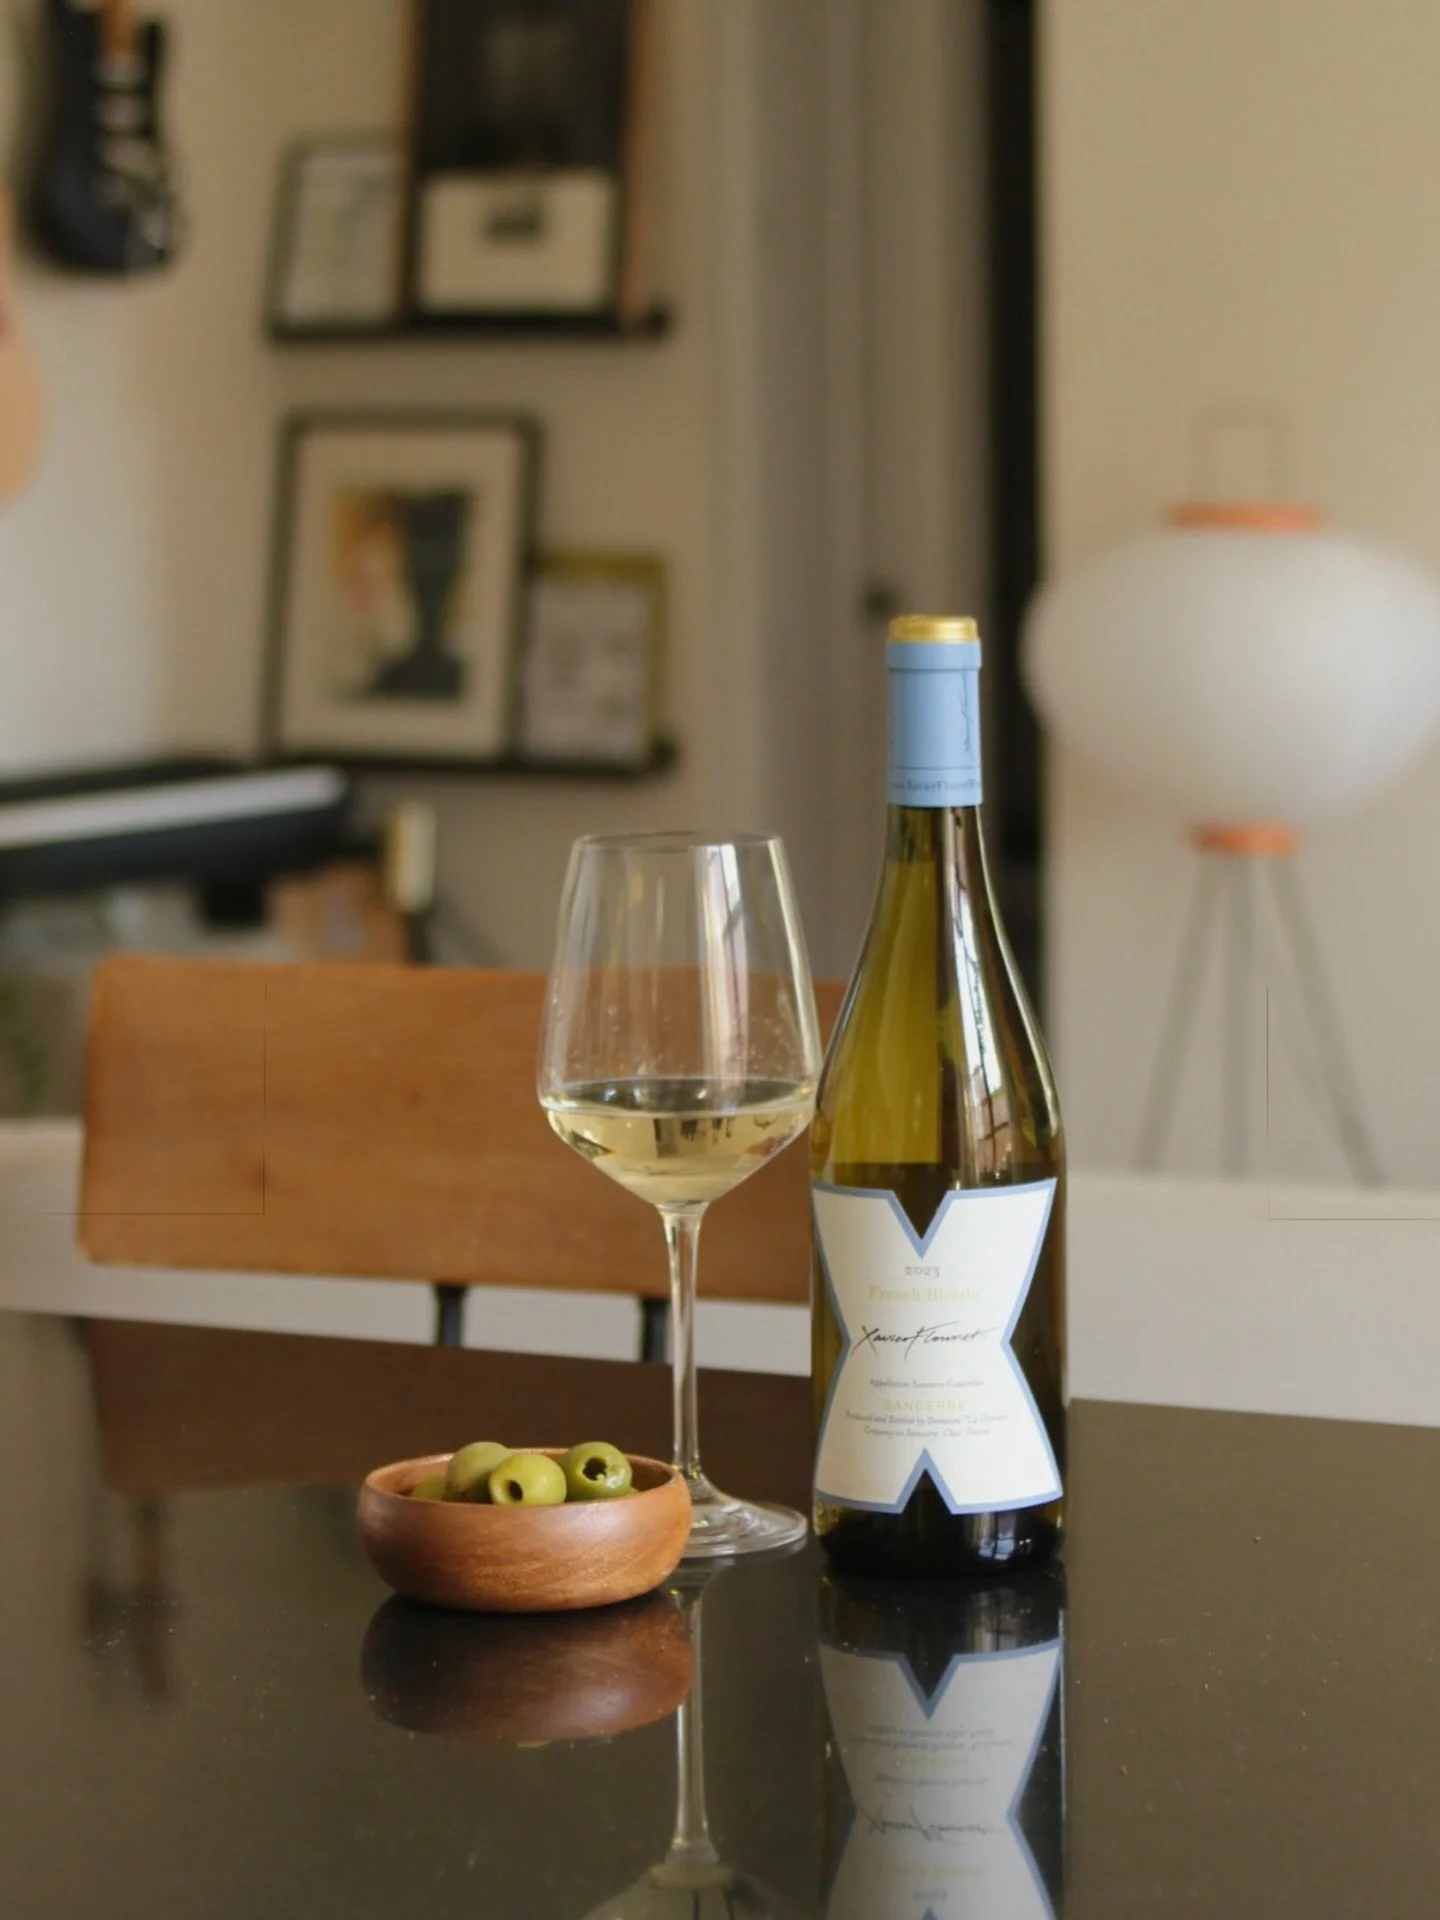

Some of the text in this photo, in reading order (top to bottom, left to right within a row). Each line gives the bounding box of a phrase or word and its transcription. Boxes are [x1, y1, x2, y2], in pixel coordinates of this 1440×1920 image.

[905, 1266, 940, 1278] 2023
[868, 1285, 980, 1302] French Blonde
[884, 1400, 966, 1411] SANCERRE
